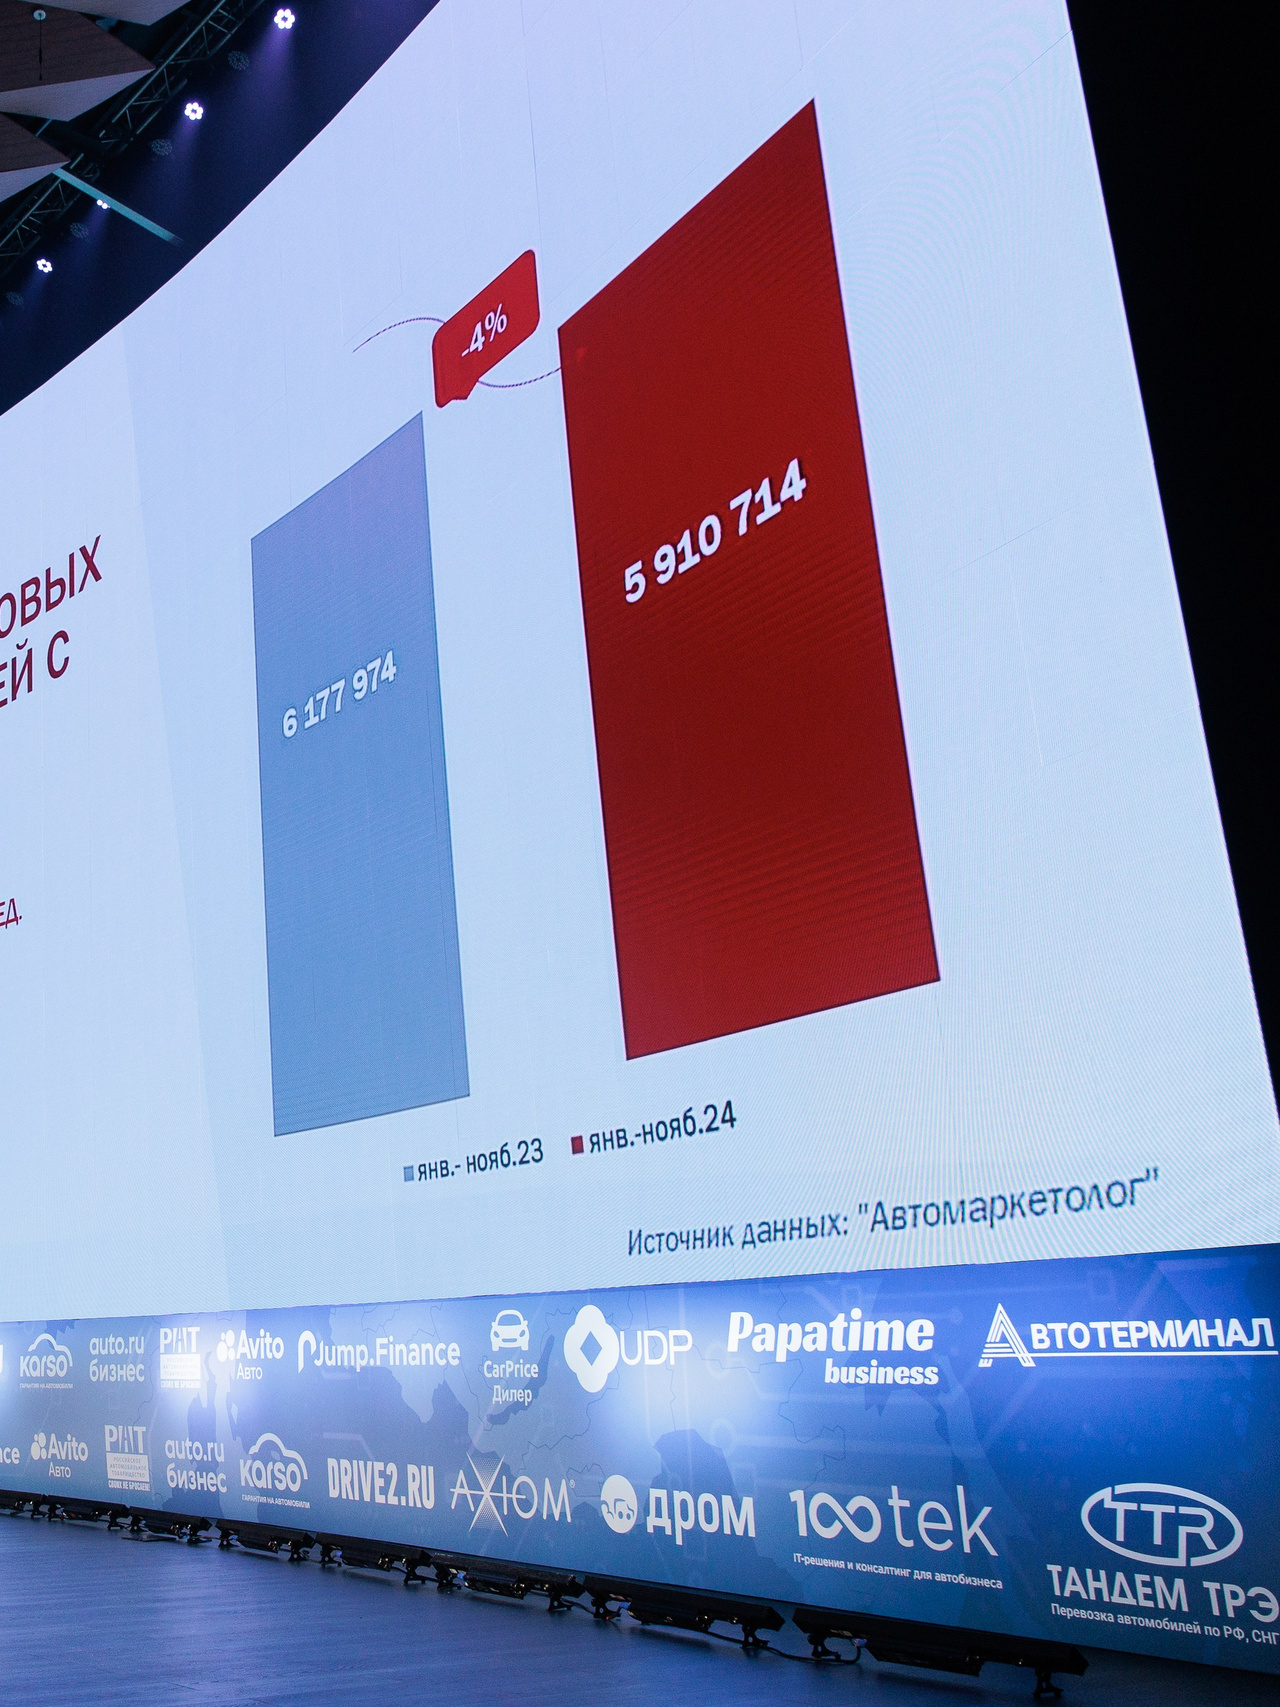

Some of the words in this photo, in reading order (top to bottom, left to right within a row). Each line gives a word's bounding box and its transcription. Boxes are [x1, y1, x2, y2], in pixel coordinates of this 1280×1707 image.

[461, 304, 509, 358] -4%
[624, 561, 647, 604] 5
[653, 514, 722, 585] 910
[729, 458, 807, 537] 714
[47, 629, 70, 679] С
[282, 709, 299, 738] 6
[303, 679, 346, 730] 177
[352, 650, 397, 699] 974
[589, 1099, 737, 1153] янв.-нояб.24
[418, 1159, 461, 1182] янв.-
[466, 1138, 544, 1174] нояб.23
[627, 1226, 735, 1256] Источник
[741, 1212, 849, 1249] данных:
[857, 1167, 1159, 1234] "Автомаркетолог"
[89, 1333, 145, 1355] auto.ru
[236, 1328, 284, 1360] Avito
[314, 1335, 460, 1371] Jump.Finance
[620, 1329, 692, 1366] UDP
[727, 1307, 935, 1363] Papatime
[89, 1358, 145, 1382] бизнес
[483, 1360, 539, 1379] CarPrice
[824, 1358, 939, 1386] business
[492, 1385, 532, 1406] Дилер
[47, 1431, 89, 1462] Avito
[165, 1437, 225, 1462] auto.ru
[166, 1462, 228, 1493] бизнес
[327, 1457, 435, 1510] DRIVE2.RU
[646, 1487, 756, 1545] дром
[793, 1552, 845, 1570] IT-решения
[847, 1560, 854, 1570] и
[855, 1561, 911, 1577] консалтинг
[913, 1569, 933, 1580] для
[934, 1571, 1003, 1589] автобизнеса
[1046, 1563, 1189, 1612] ТАНДЕМ
[1050, 1602, 1115, 1623] Перевозка
[1117, 1612, 1202, 1635] автомобилей
[1203, 1624, 1220, 1637] по
[1223, 1625, 1249, 1643] РФ,
[1251, 1629, 1280, 1645] СНГ
